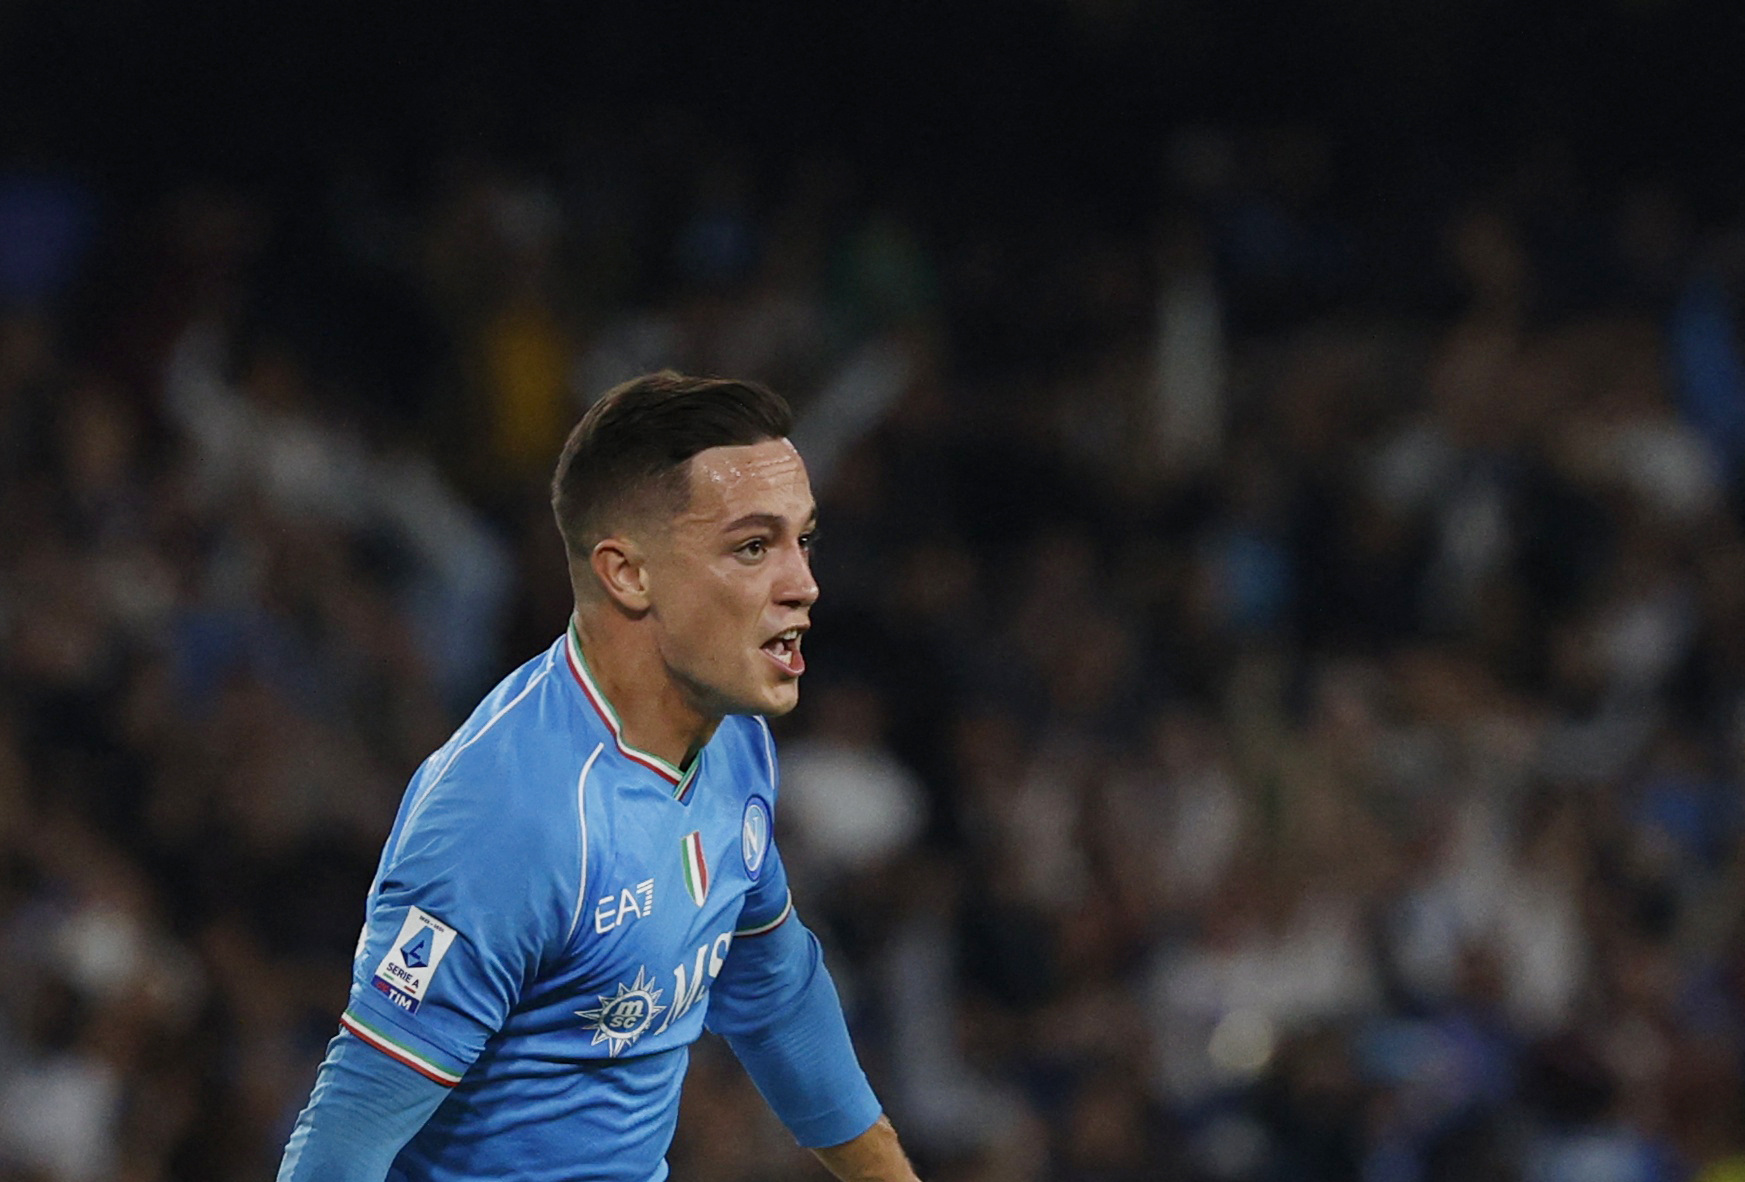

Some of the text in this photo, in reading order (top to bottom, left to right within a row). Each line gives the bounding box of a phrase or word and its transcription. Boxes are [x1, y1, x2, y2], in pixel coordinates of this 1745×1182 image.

[594, 877, 655, 934] EA7
[386, 962, 420, 989] SERIE A
[387, 988, 413, 1011] TIM
